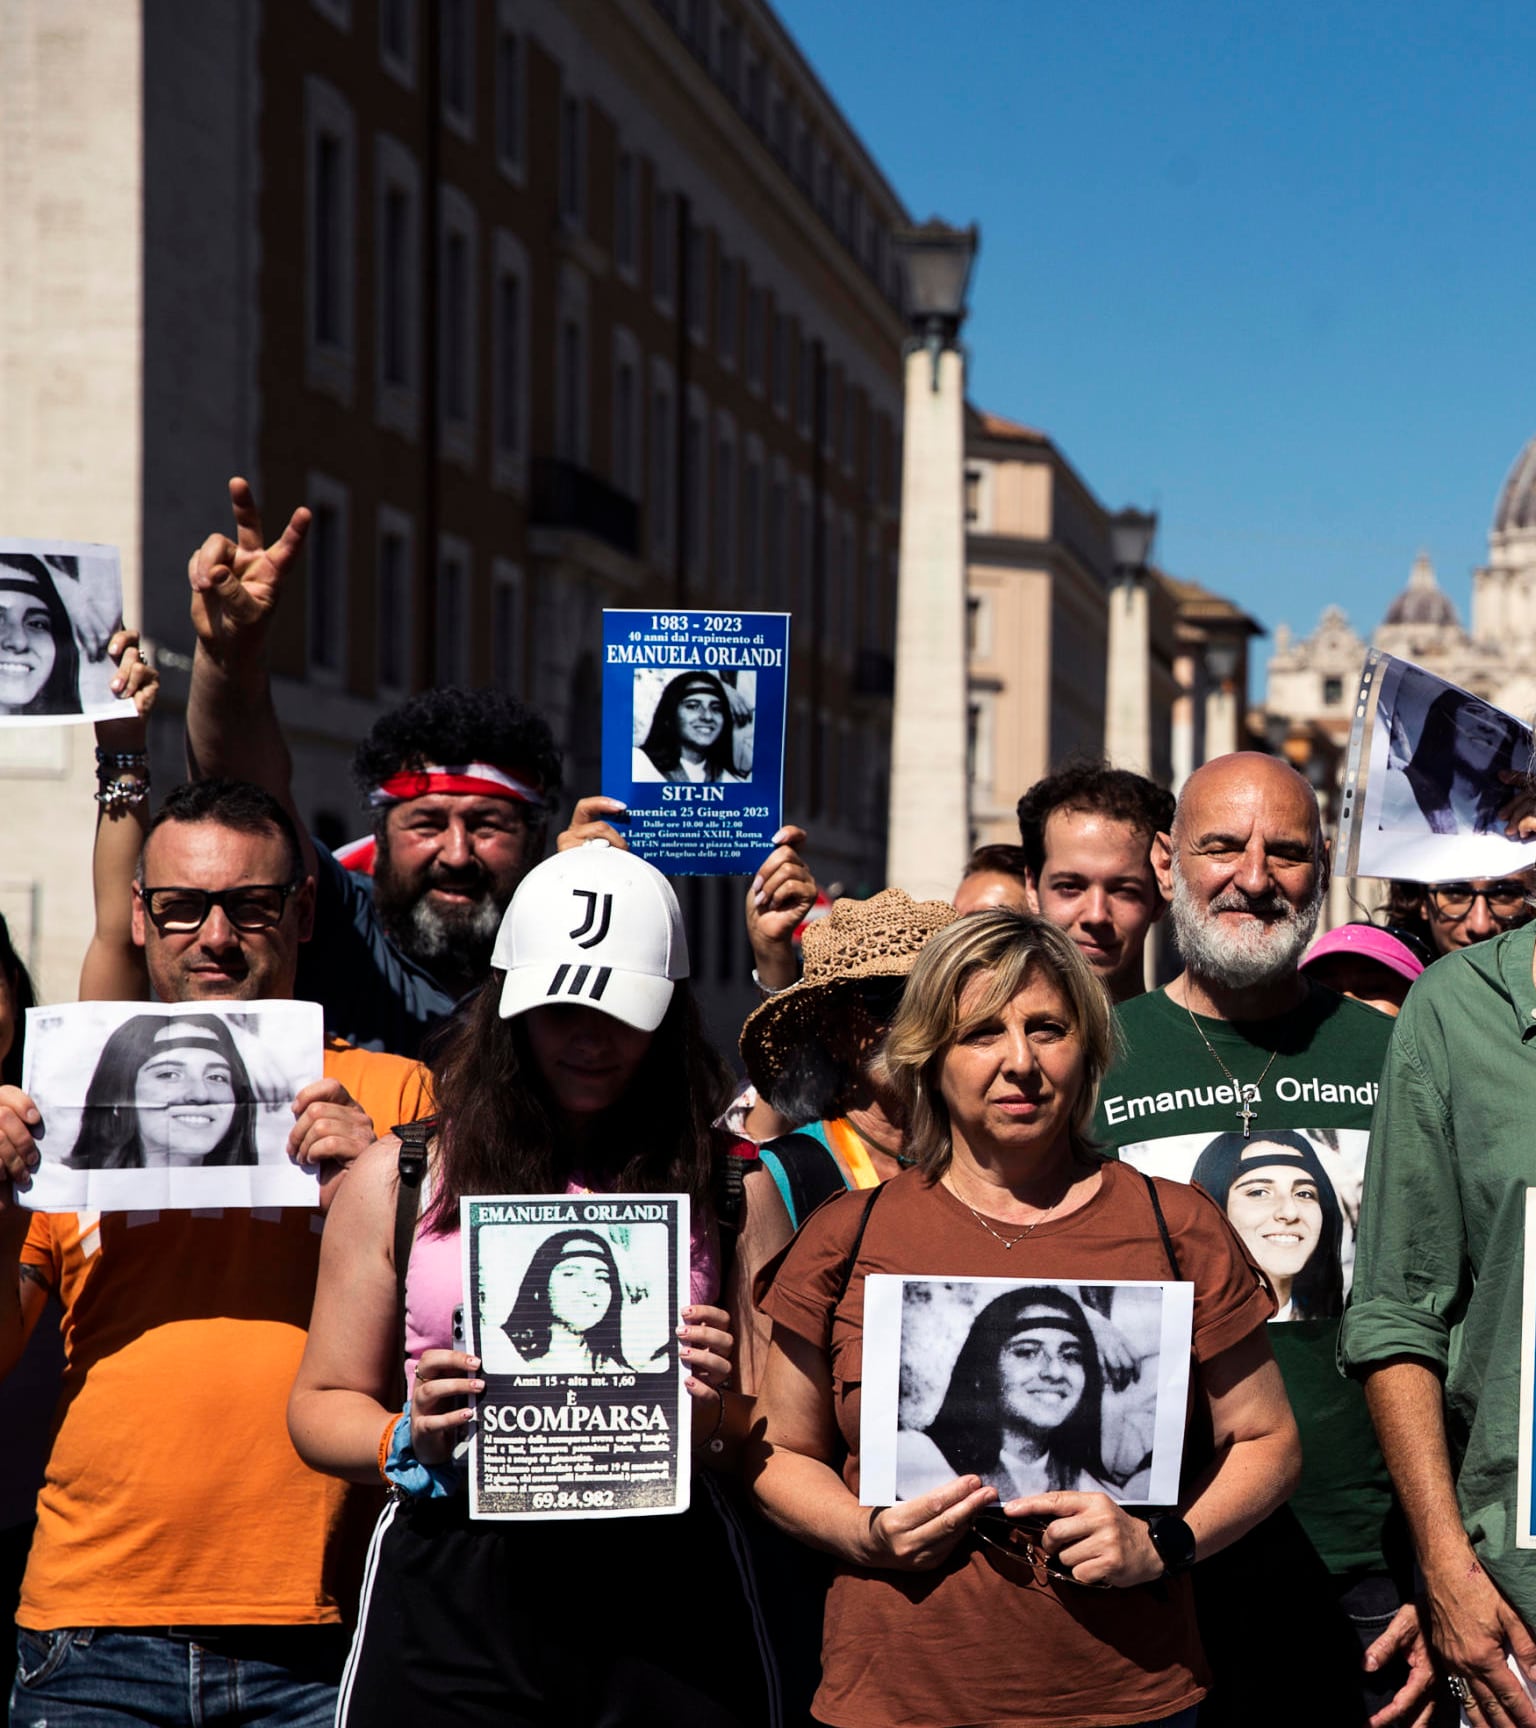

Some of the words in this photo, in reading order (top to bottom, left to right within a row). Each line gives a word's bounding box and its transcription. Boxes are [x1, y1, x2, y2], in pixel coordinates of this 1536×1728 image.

[651, 616, 688, 630] 1983
[704, 617, 742, 632] 2023
[628, 631, 641, 642] 40
[644, 632, 668, 642] anni
[671, 632, 689, 643] dal
[692, 633, 750, 646] rapimento
[753, 634, 764, 645] di
[606, 645, 701, 664] EMANUELA
[704, 647, 782, 667] ORLANDI
[662, 785, 724, 801] SIT-IN
[625, 806, 677, 818] omenica
[680, 806, 694, 817] 25
[697, 806, 740, 820] Giugno
[743, 806, 769, 817] 2023
[643, 820, 665, 828] Dalle
[682, 820, 704, 828] 10.00
[705, 820, 720, 828] alle
[722, 820, 743, 828] 12.00
[628, 829, 656, 840] Largo
[657, 829, 701, 838] Giovanni
[703, 830, 733, 839] XXIII,
[735, 830, 763, 838] Roma
[631, 840, 659, 848] SIT-IN
[661, 840, 698, 848] andremo
[706, 840, 733, 849] piazza
[734, 840, 749, 848] San
[750, 840, 775, 848] Pietro
[643, 851, 658, 859] per
[659, 850, 696, 859] l'Angelus
[719, 850, 741, 858] 12.00
[1103, 1079, 1261, 1125] Emanuela
[1275, 1077, 1379, 1105] Orlandi
[478, 1205, 579, 1223] EMANUELA
[583, 1204, 669, 1222] ORLANDI
[513, 1376, 541, 1387] Anni
[545, 1376, 558, 1387] 15
[567, 1376, 589, 1387] alta
[591, 1376, 609, 1387] mt.
[612, 1375, 636, 1388] 1,60
[566, 1389, 577, 1406] È
[483, 1404, 670, 1432] SCOMPARSA
[532, 1491, 615, 1509] 69.84.982
